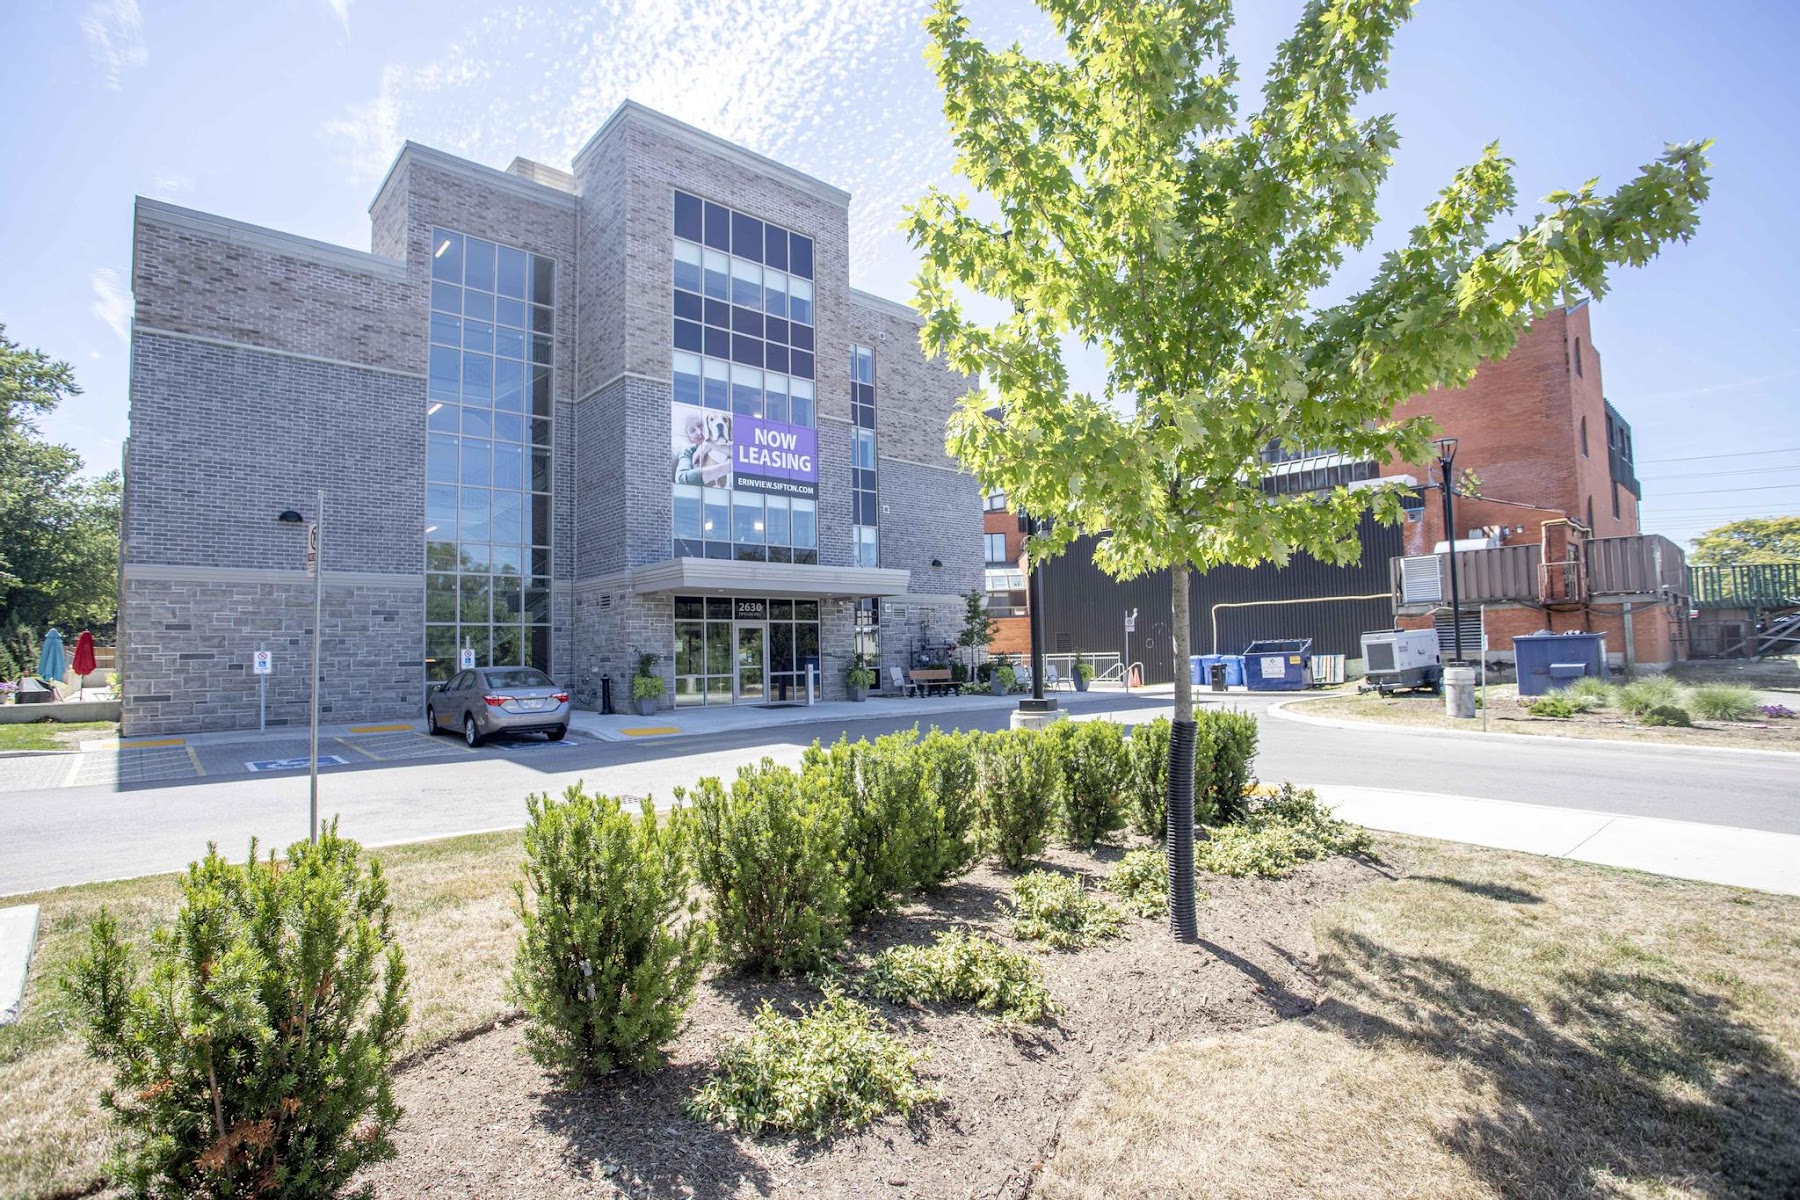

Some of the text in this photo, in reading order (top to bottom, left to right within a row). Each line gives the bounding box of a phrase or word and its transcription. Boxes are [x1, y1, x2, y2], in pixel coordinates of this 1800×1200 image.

[755, 428, 797, 450] NOW
[739, 445, 811, 472] LEASING
[738, 477, 814, 494] ERINVIEW.SIFTON.COM
[739, 602, 762, 612] 2630
